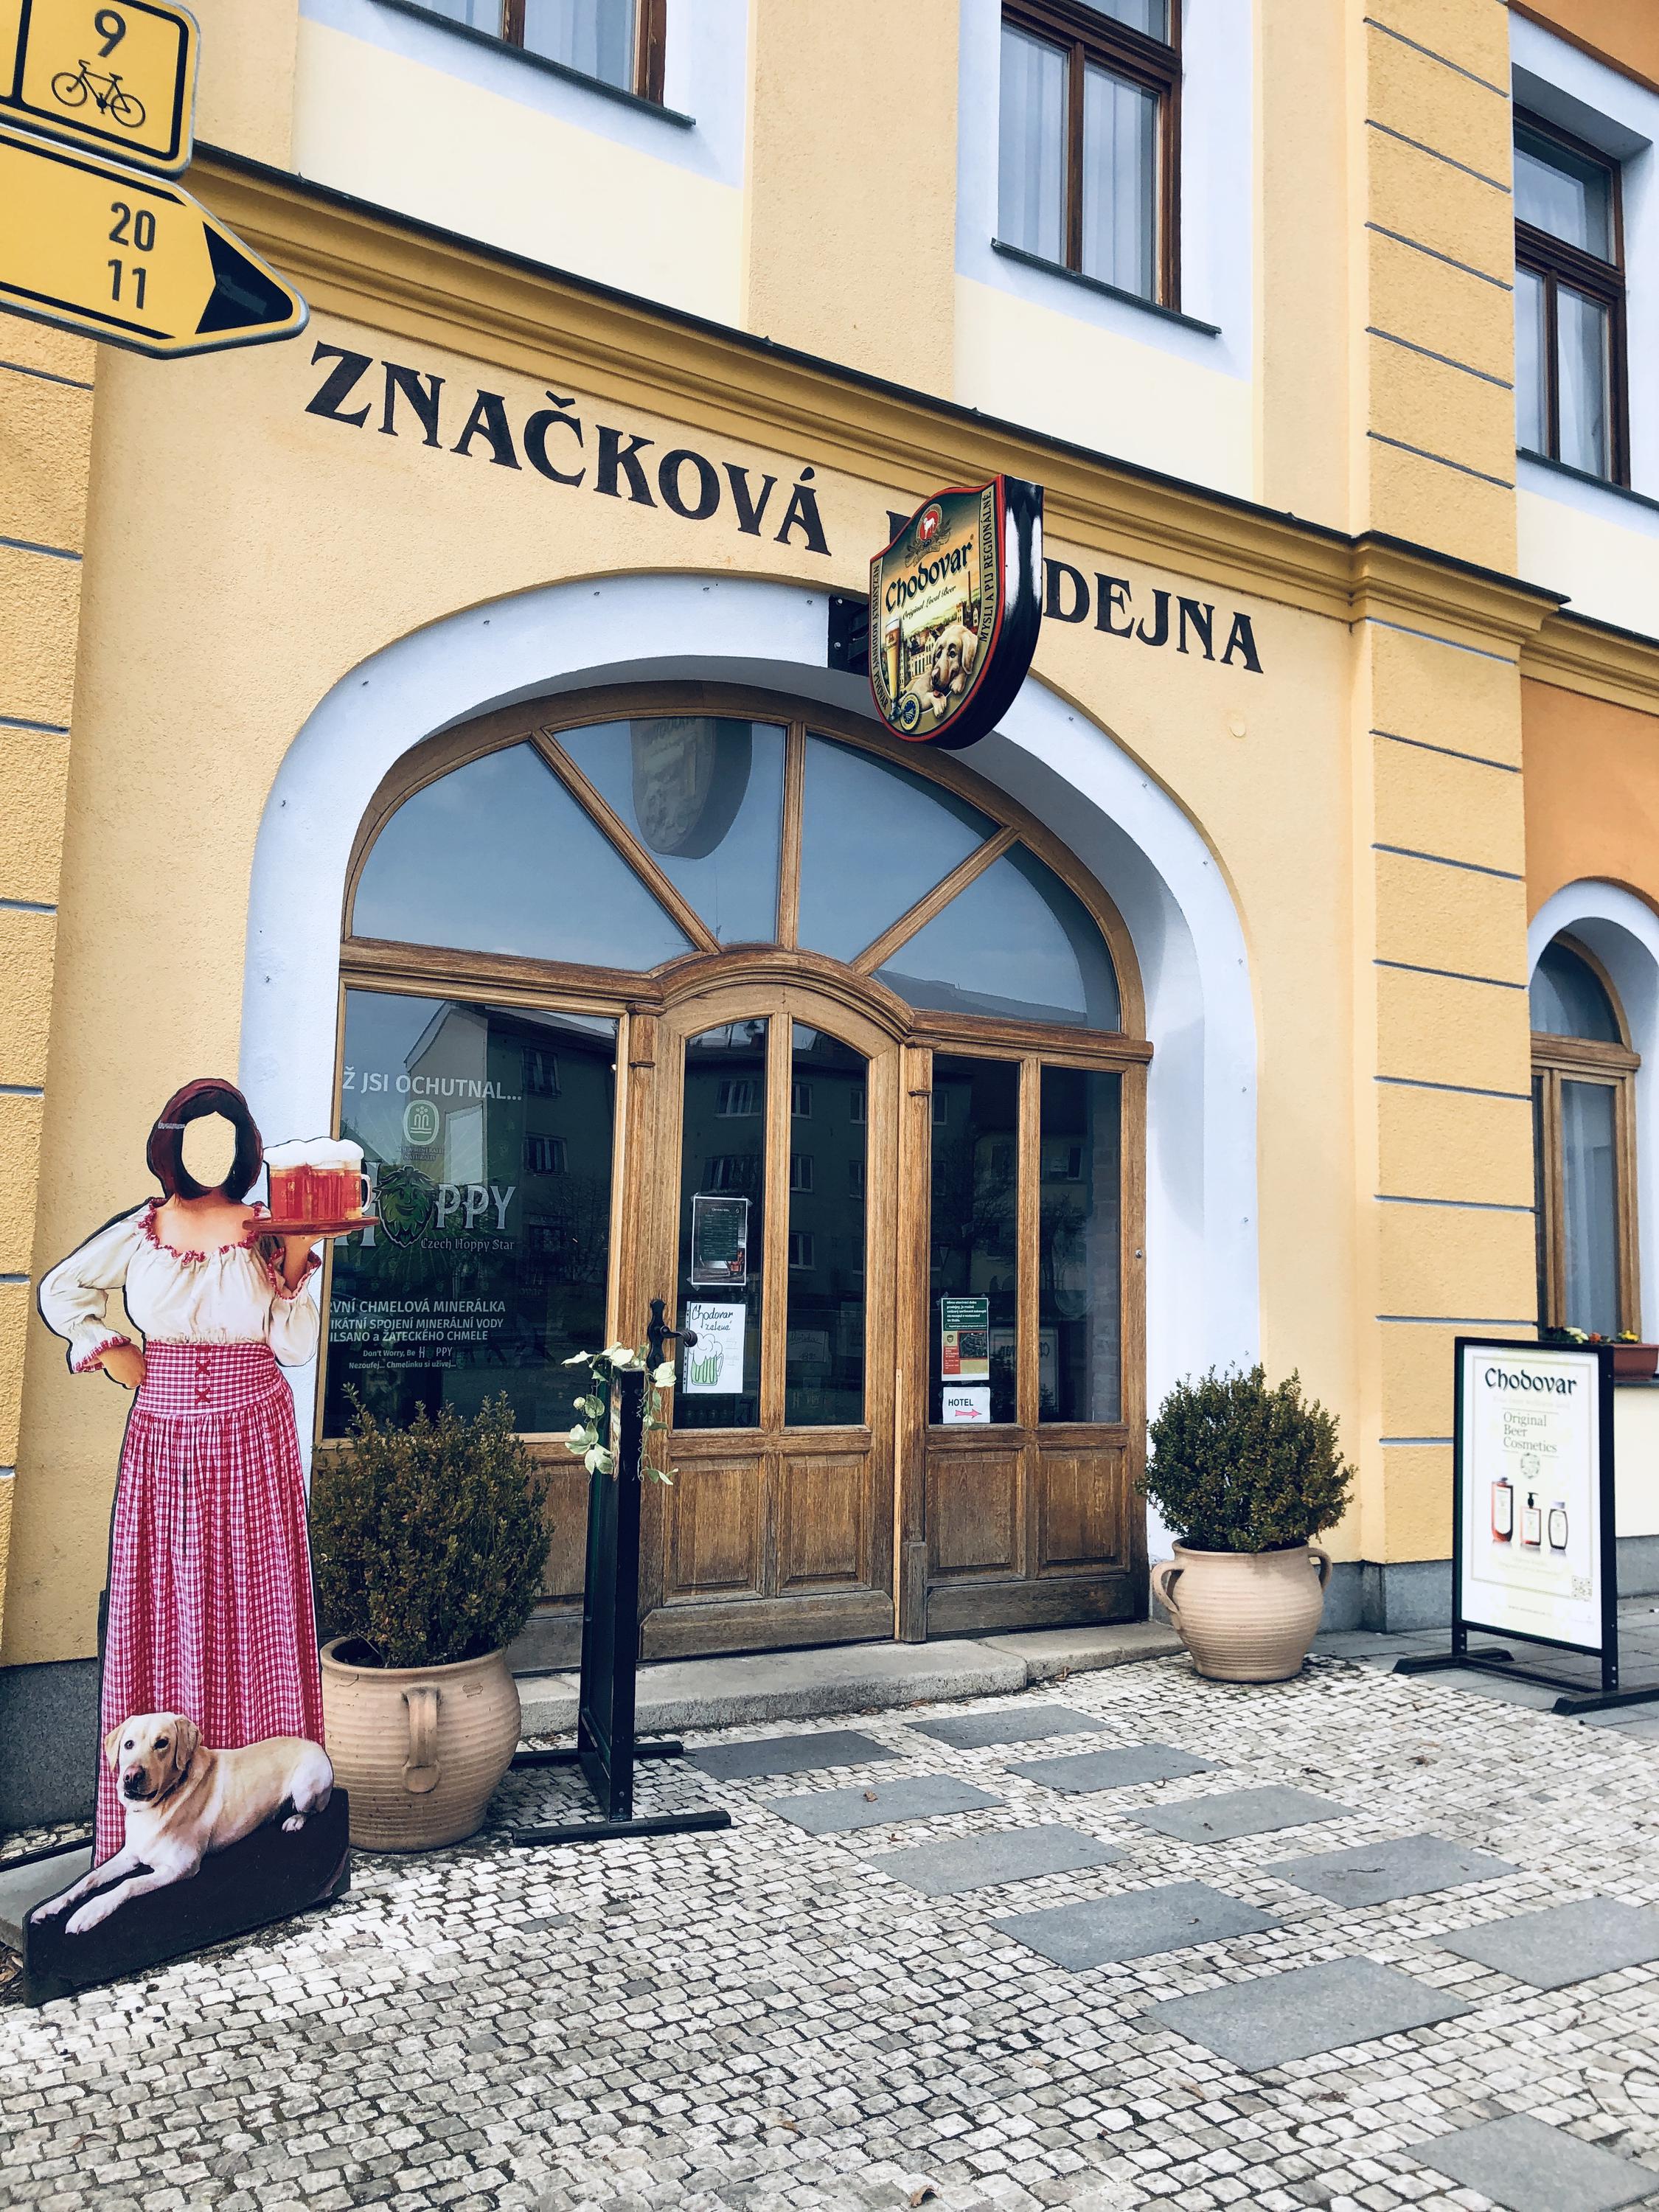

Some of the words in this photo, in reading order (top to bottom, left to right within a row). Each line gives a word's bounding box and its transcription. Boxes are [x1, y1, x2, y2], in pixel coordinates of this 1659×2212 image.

[94, 9, 127, 58] 9
[108, 201, 156, 251] 20
[108, 259, 147, 310] 11
[305, 341, 832, 556] ZNAČKOVÁ
[981, 491, 993, 569] REGIONÁLNĚ
[886, 542, 973, 612] Chodovar
[984, 572, 994, 592] PIJ
[985, 593, 994, 601] A
[979, 605, 993, 642] MYSLI
[874, 670, 888, 709] PIVOVAR
[360, 1073, 389, 1094] JSI
[395, 1074, 522, 1101] OCHUTNAL...
[420, 1238, 452, 1251] Czech
[455, 1238, 490, 1252] Hoppy
[492, 1239, 515, 1250] Star
[359, 1298, 430, 1312] CHMELOVÁ
[433, 1298, 506, 1312] MINERÁLKA
[692, 1304, 734, 1328] Chodovar
[369, 1316, 414, 1330] SPOJENÍ
[416, 1316, 474, 1329] MINERÁLNÍ
[476, 1318, 504, 1328] VODY
[372, 1333, 380, 1341] a
[382, 1329, 444, 1341] ŽATECKÉHO
[447, 1330, 488, 1340] CHMELE
[424, 1360, 430, 1368] si
[1484, 1368, 1577, 1395] Chodovar
[948, 1398, 974, 1407] HOTEL
[1503, 1411, 1547, 1427] Original
[1504, 1424, 1528, 1437] Beer
[1503, 1436, 1557, 1453] Cosmetics
